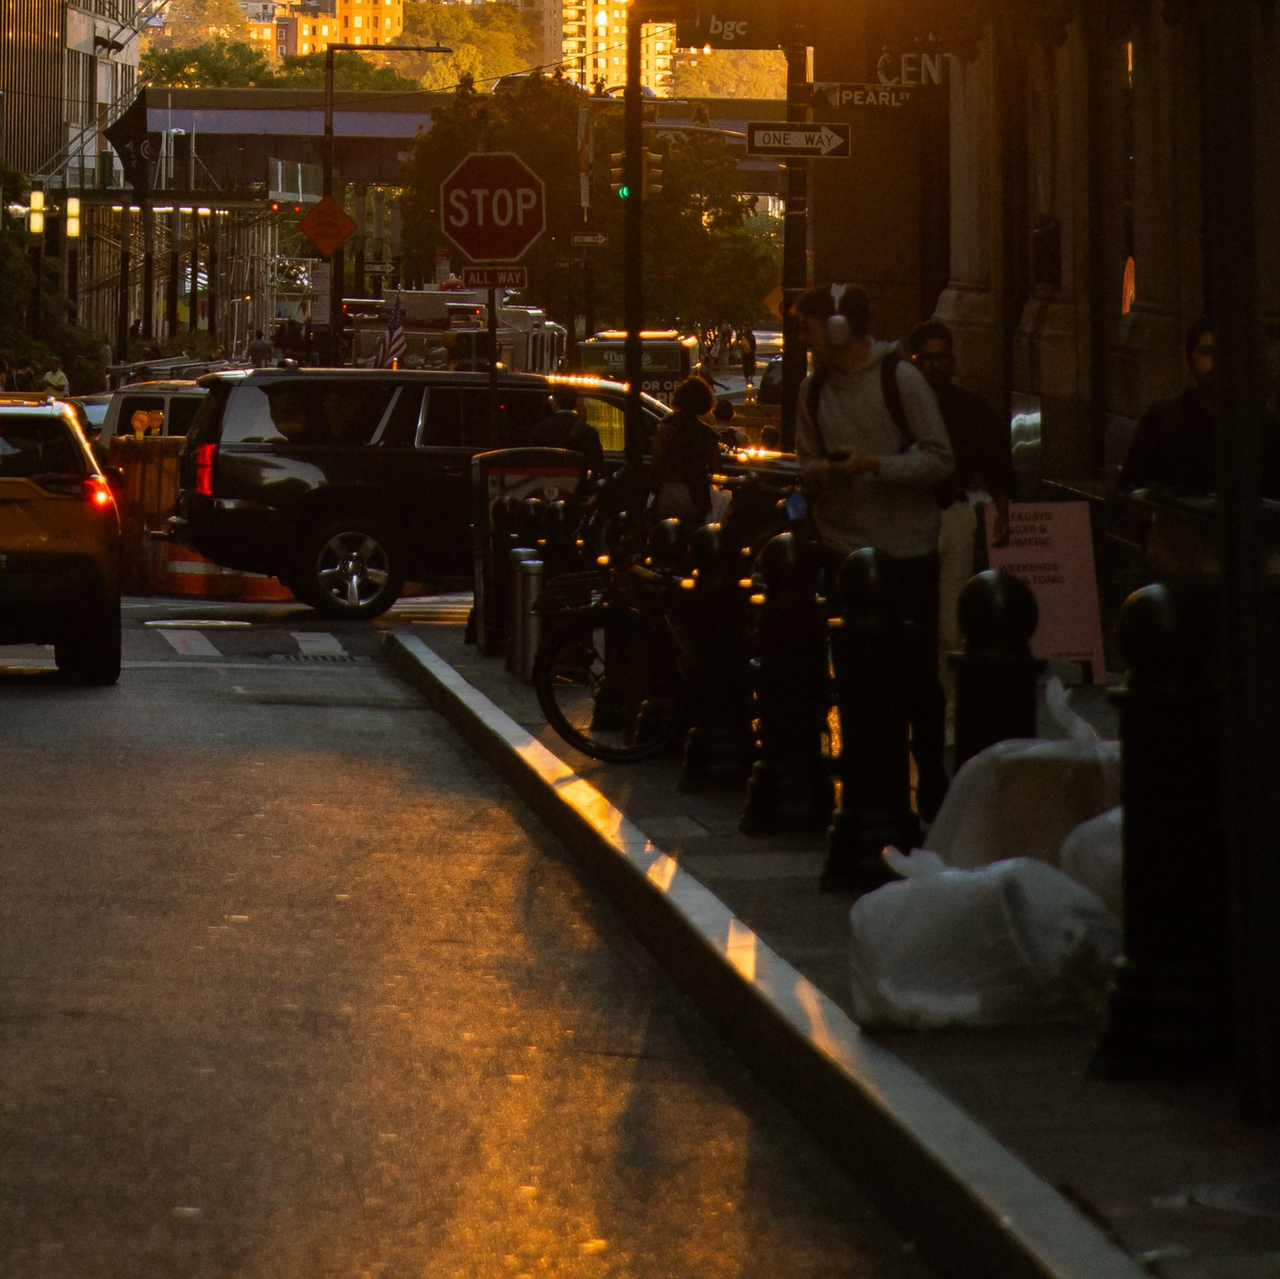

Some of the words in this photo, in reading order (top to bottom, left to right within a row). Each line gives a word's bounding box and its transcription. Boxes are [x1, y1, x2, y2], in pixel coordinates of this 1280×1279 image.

[709, 14, 748, 41] bgc
[841, 90, 902, 107] PEARL
[900, 92, 911, 101] ST
[762, 132, 791, 146] ONE
[804, 134, 834, 147] WAY
[448, 188, 538, 228] STOP
[468, 273, 491, 284] ALL
[497, 272, 521, 284] WAY
